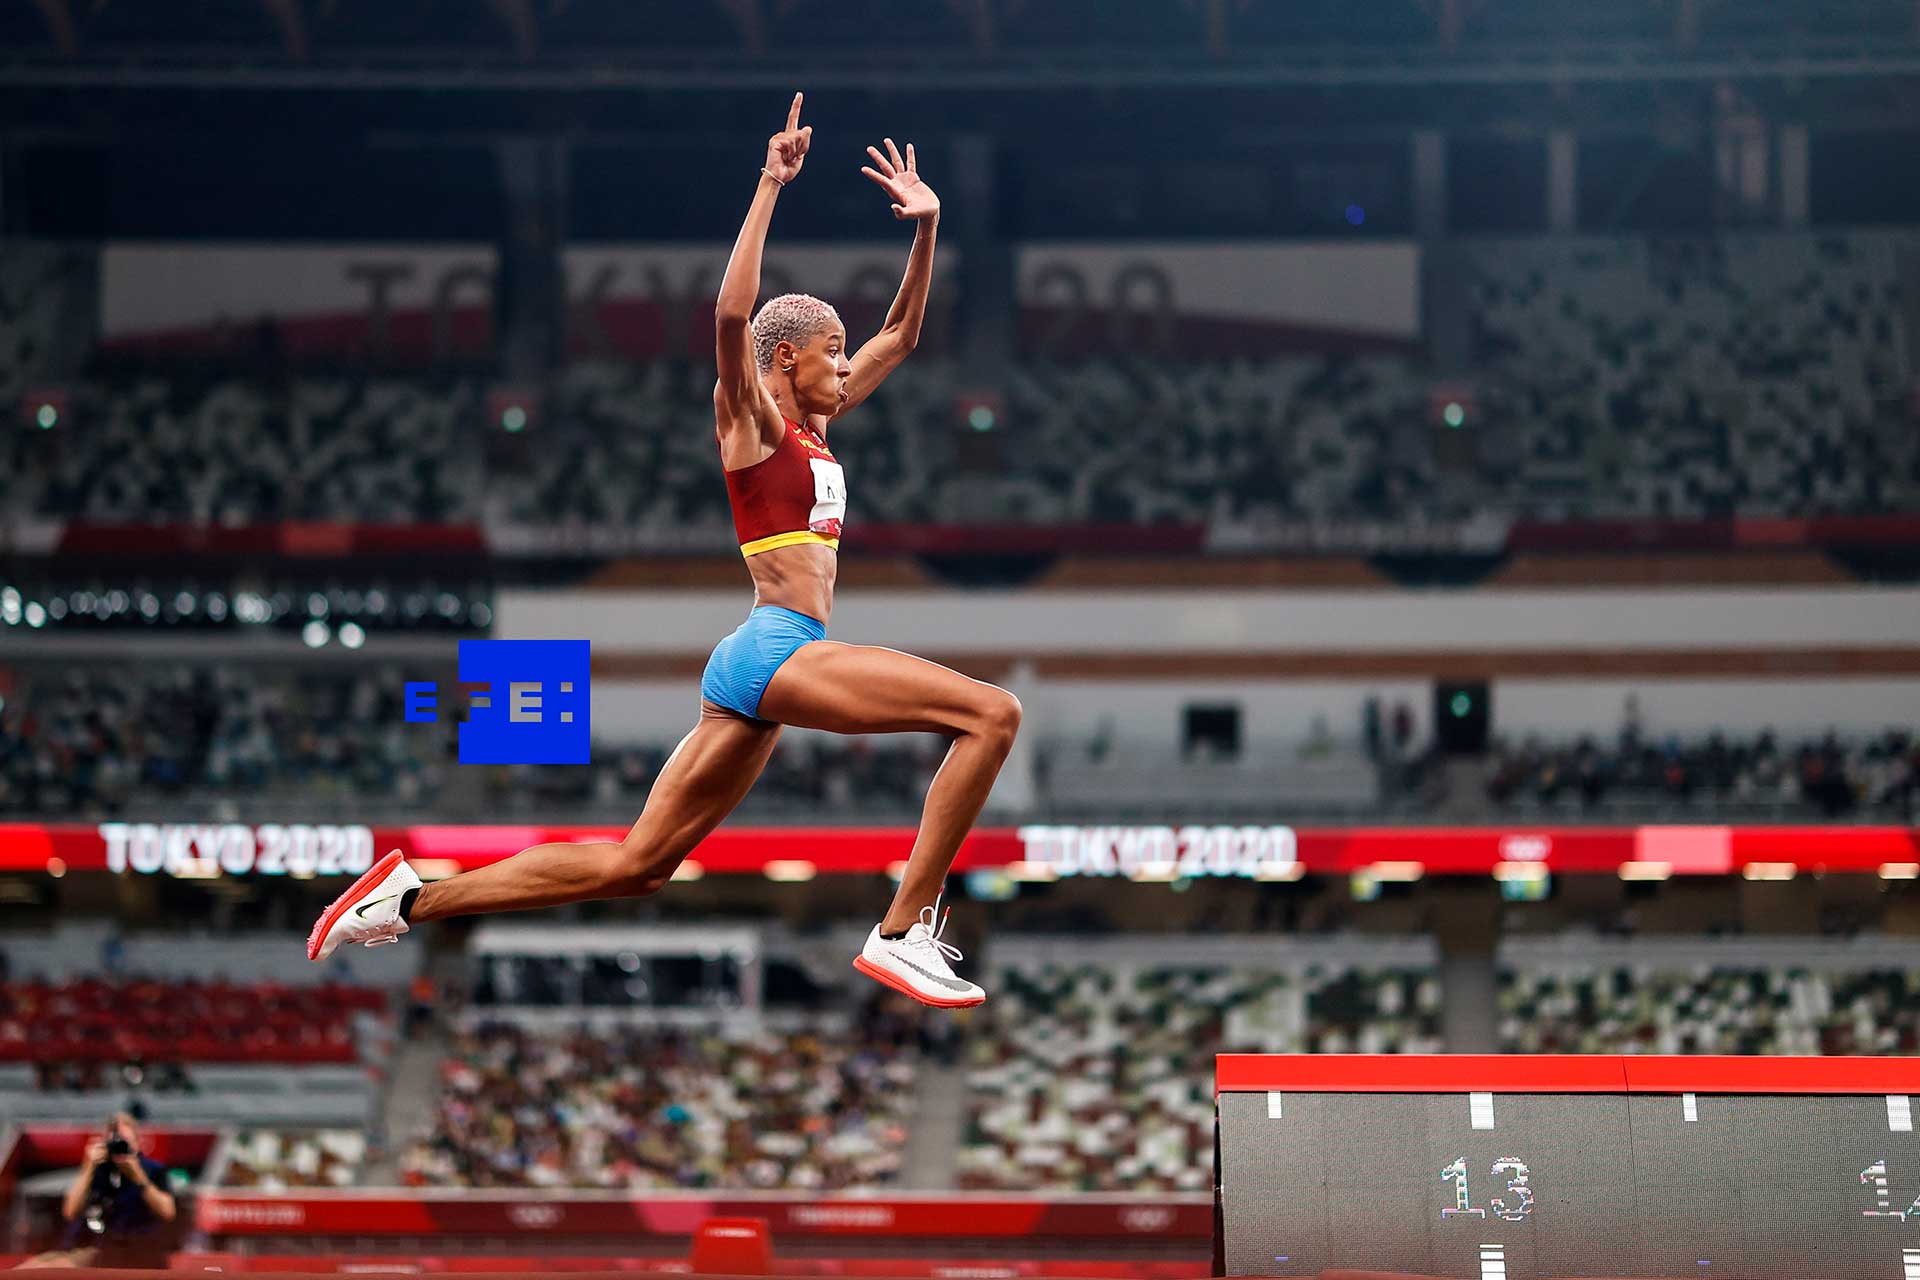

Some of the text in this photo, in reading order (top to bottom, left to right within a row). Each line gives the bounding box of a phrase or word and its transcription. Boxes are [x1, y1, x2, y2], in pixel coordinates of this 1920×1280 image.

[97, 822, 374, 876] TOKYO 2020
[1018, 825, 1298, 877] TOKYO 2020
[1441, 1157, 1534, 1220] 13
[1859, 1160, 1920, 1222] 1
